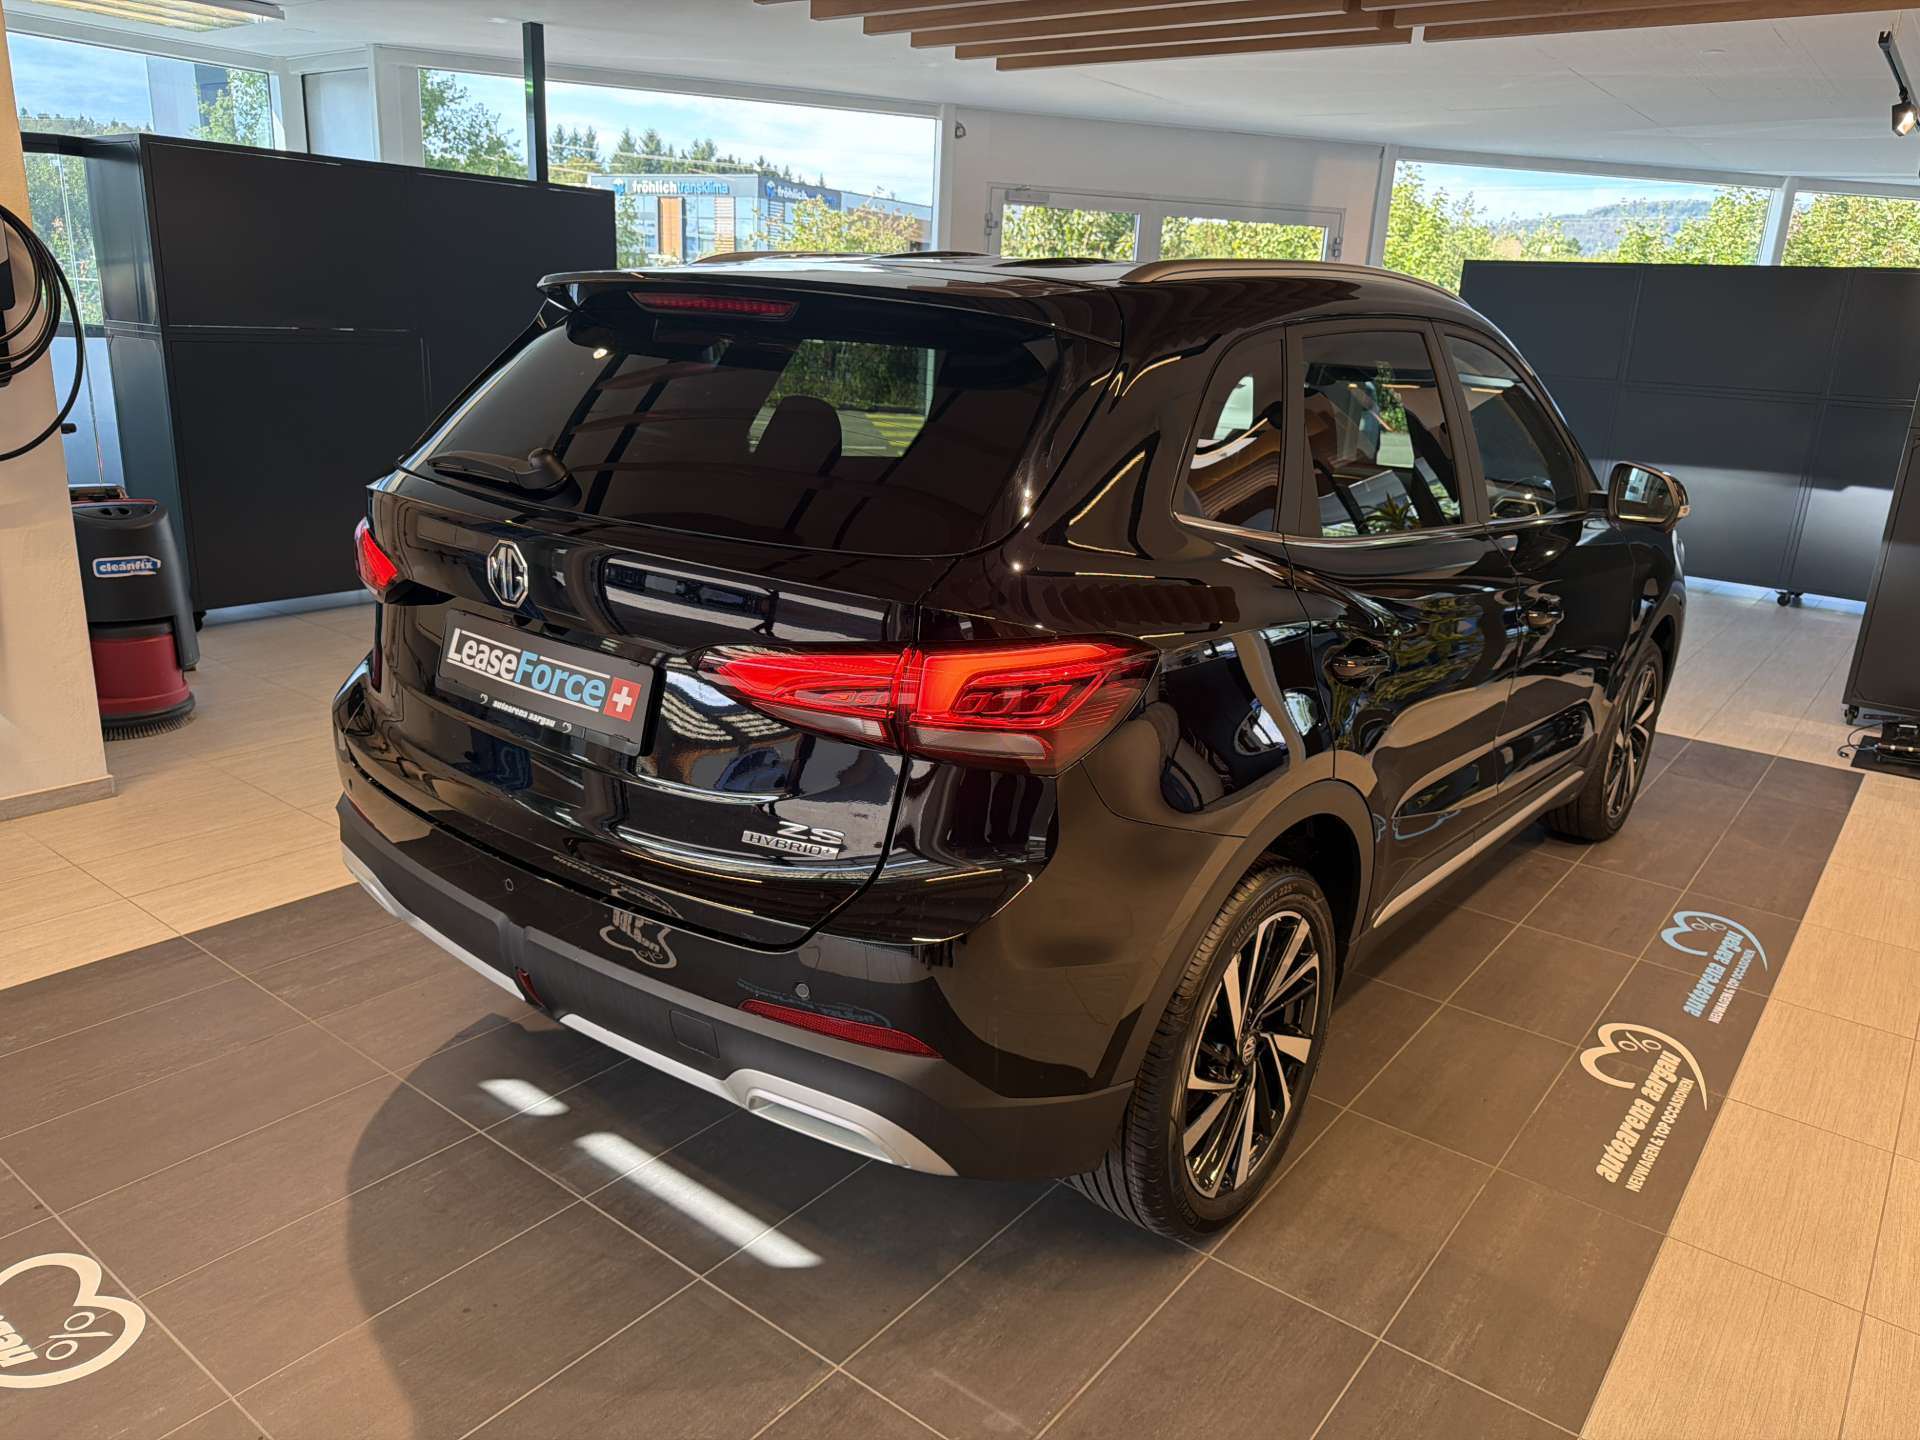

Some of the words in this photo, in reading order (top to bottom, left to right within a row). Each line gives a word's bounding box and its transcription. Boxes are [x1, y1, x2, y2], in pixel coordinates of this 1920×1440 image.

[100, 559, 153, 571] cleanfix
[447, 628, 606, 707] LeaseForce
[777, 820, 845, 844] ZS
[1683, 962, 1726, 1017] autoarena
[1713, 930, 1744, 965] aargau
[1596, 1098, 1656, 1183] autoarena
[1641, 1050, 1681, 1102] aargau
[1653, 1121, 1671, 1139] TOP
[1649, 1137, 1665, 1147] &
[1625, 1143, 1661, 1192] NEUWAGEN
